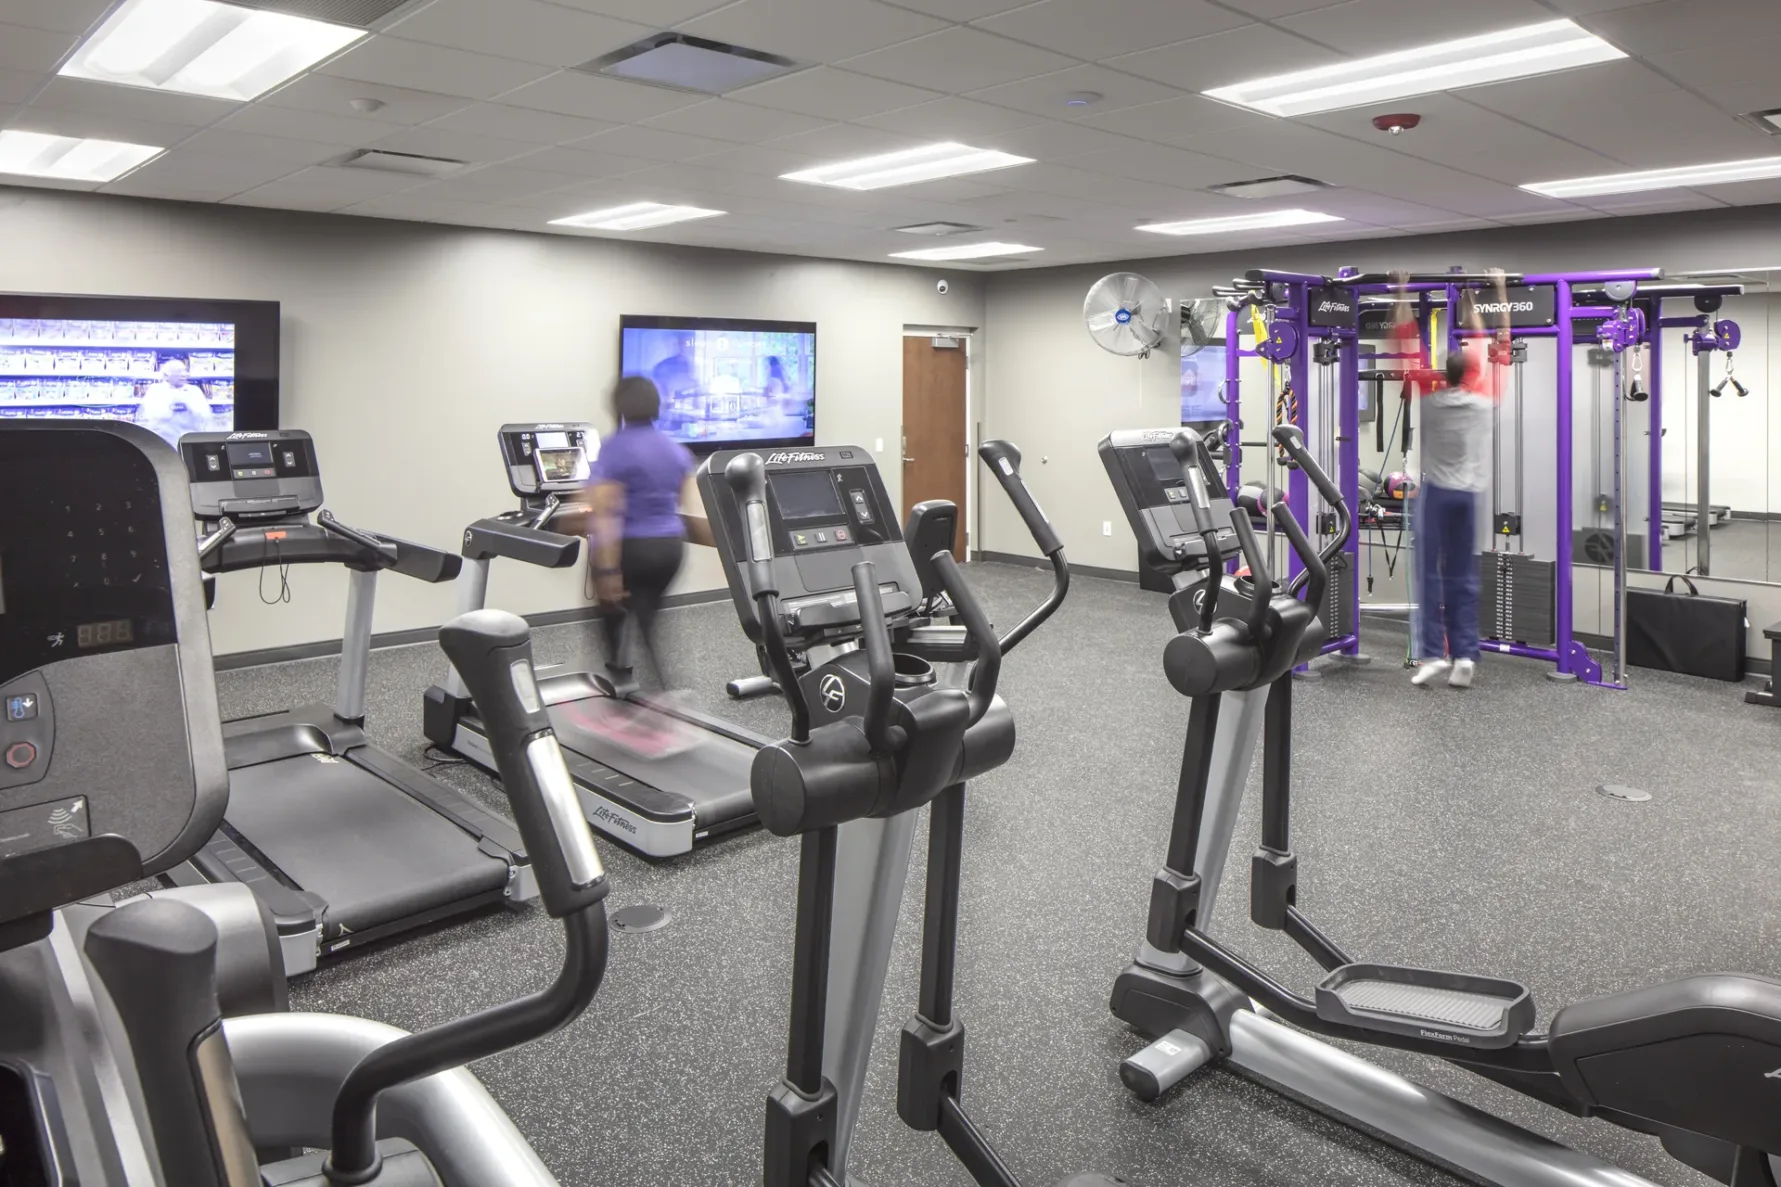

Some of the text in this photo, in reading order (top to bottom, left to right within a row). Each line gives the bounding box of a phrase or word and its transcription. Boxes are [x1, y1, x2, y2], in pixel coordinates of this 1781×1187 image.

[1473, 301, 1533, 314] SYNRGY360
[96, 503, 102, 511] 2
[126, 501, 132, 509] 3
